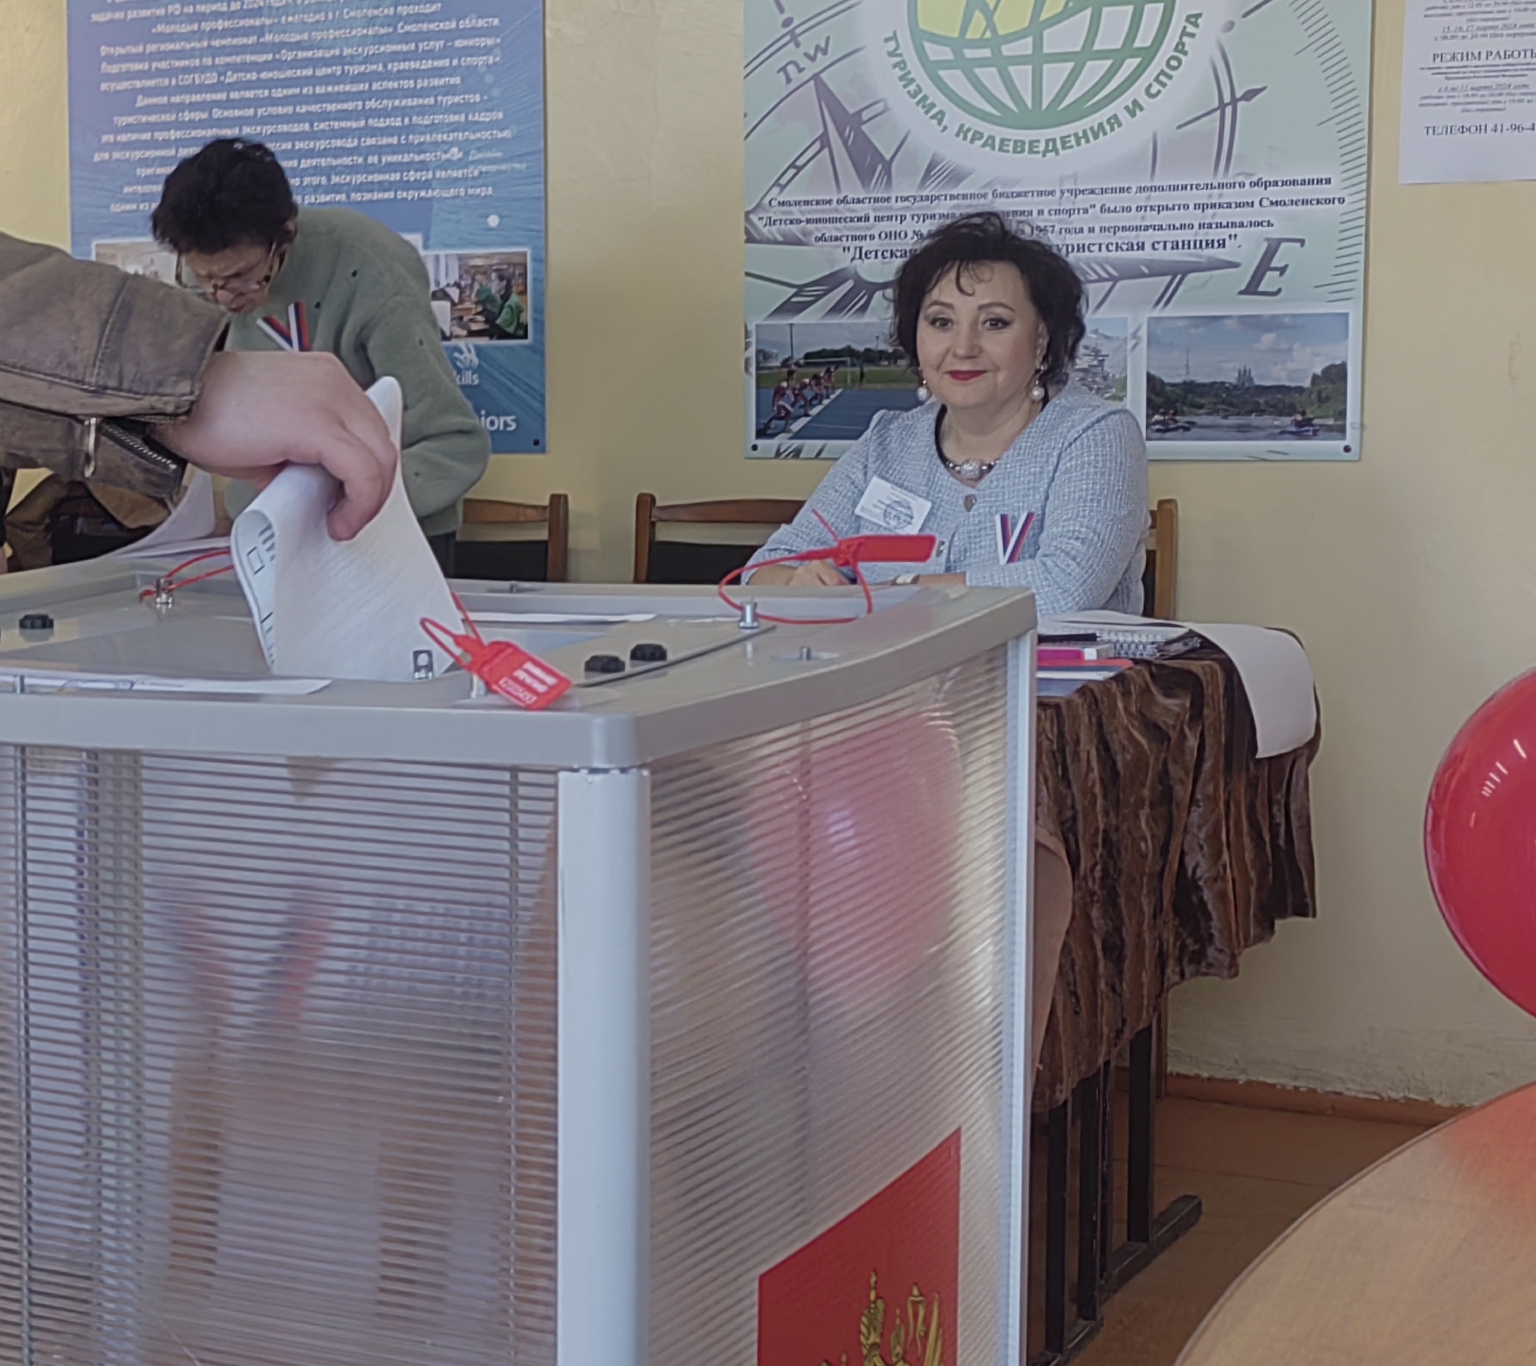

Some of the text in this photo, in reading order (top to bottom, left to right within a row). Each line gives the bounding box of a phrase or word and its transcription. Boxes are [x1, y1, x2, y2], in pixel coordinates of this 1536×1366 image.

[1432, 51, 1481, 63] РЕЖИМ
[883, 12, 1202, 158] ТУРИЗМА, КРАЕВЕДЕНИЯ И СПОРТА
[1424, 123, 1487, 136] ТЕЛЕФОН
[768, 177, 1331, 208] Смоленское областное государственное бюджетное учреждение дополнительного образования
[758, 212, 870, 229] "Детско-юношеский
[872, 213, 906, 225] центр
[1047, 204, 1096, 218] спорта"
[1099, 204, 1132, 214] было
[1135, 203, 1190, 215] открыто
[1192, 200, 1254, 213] приказом
[1258, 197, 1345, 208] Смоленского
[814, 232, 874, 242] областного
[878, 230, 908, 240] ОНО
[1058, 226, 1084, 237] года
[1088, 226, 1096, 234] и
[1098, 222, 1194, 236] первоначально
[1198, 220, 1274, 230] называлось
[1056, 239, 1145, 257] уристская
[1151, 233, 1241, 249] станция".
[1237, 237, 1305, 296] E
[480, 410, 516, 431] iors
